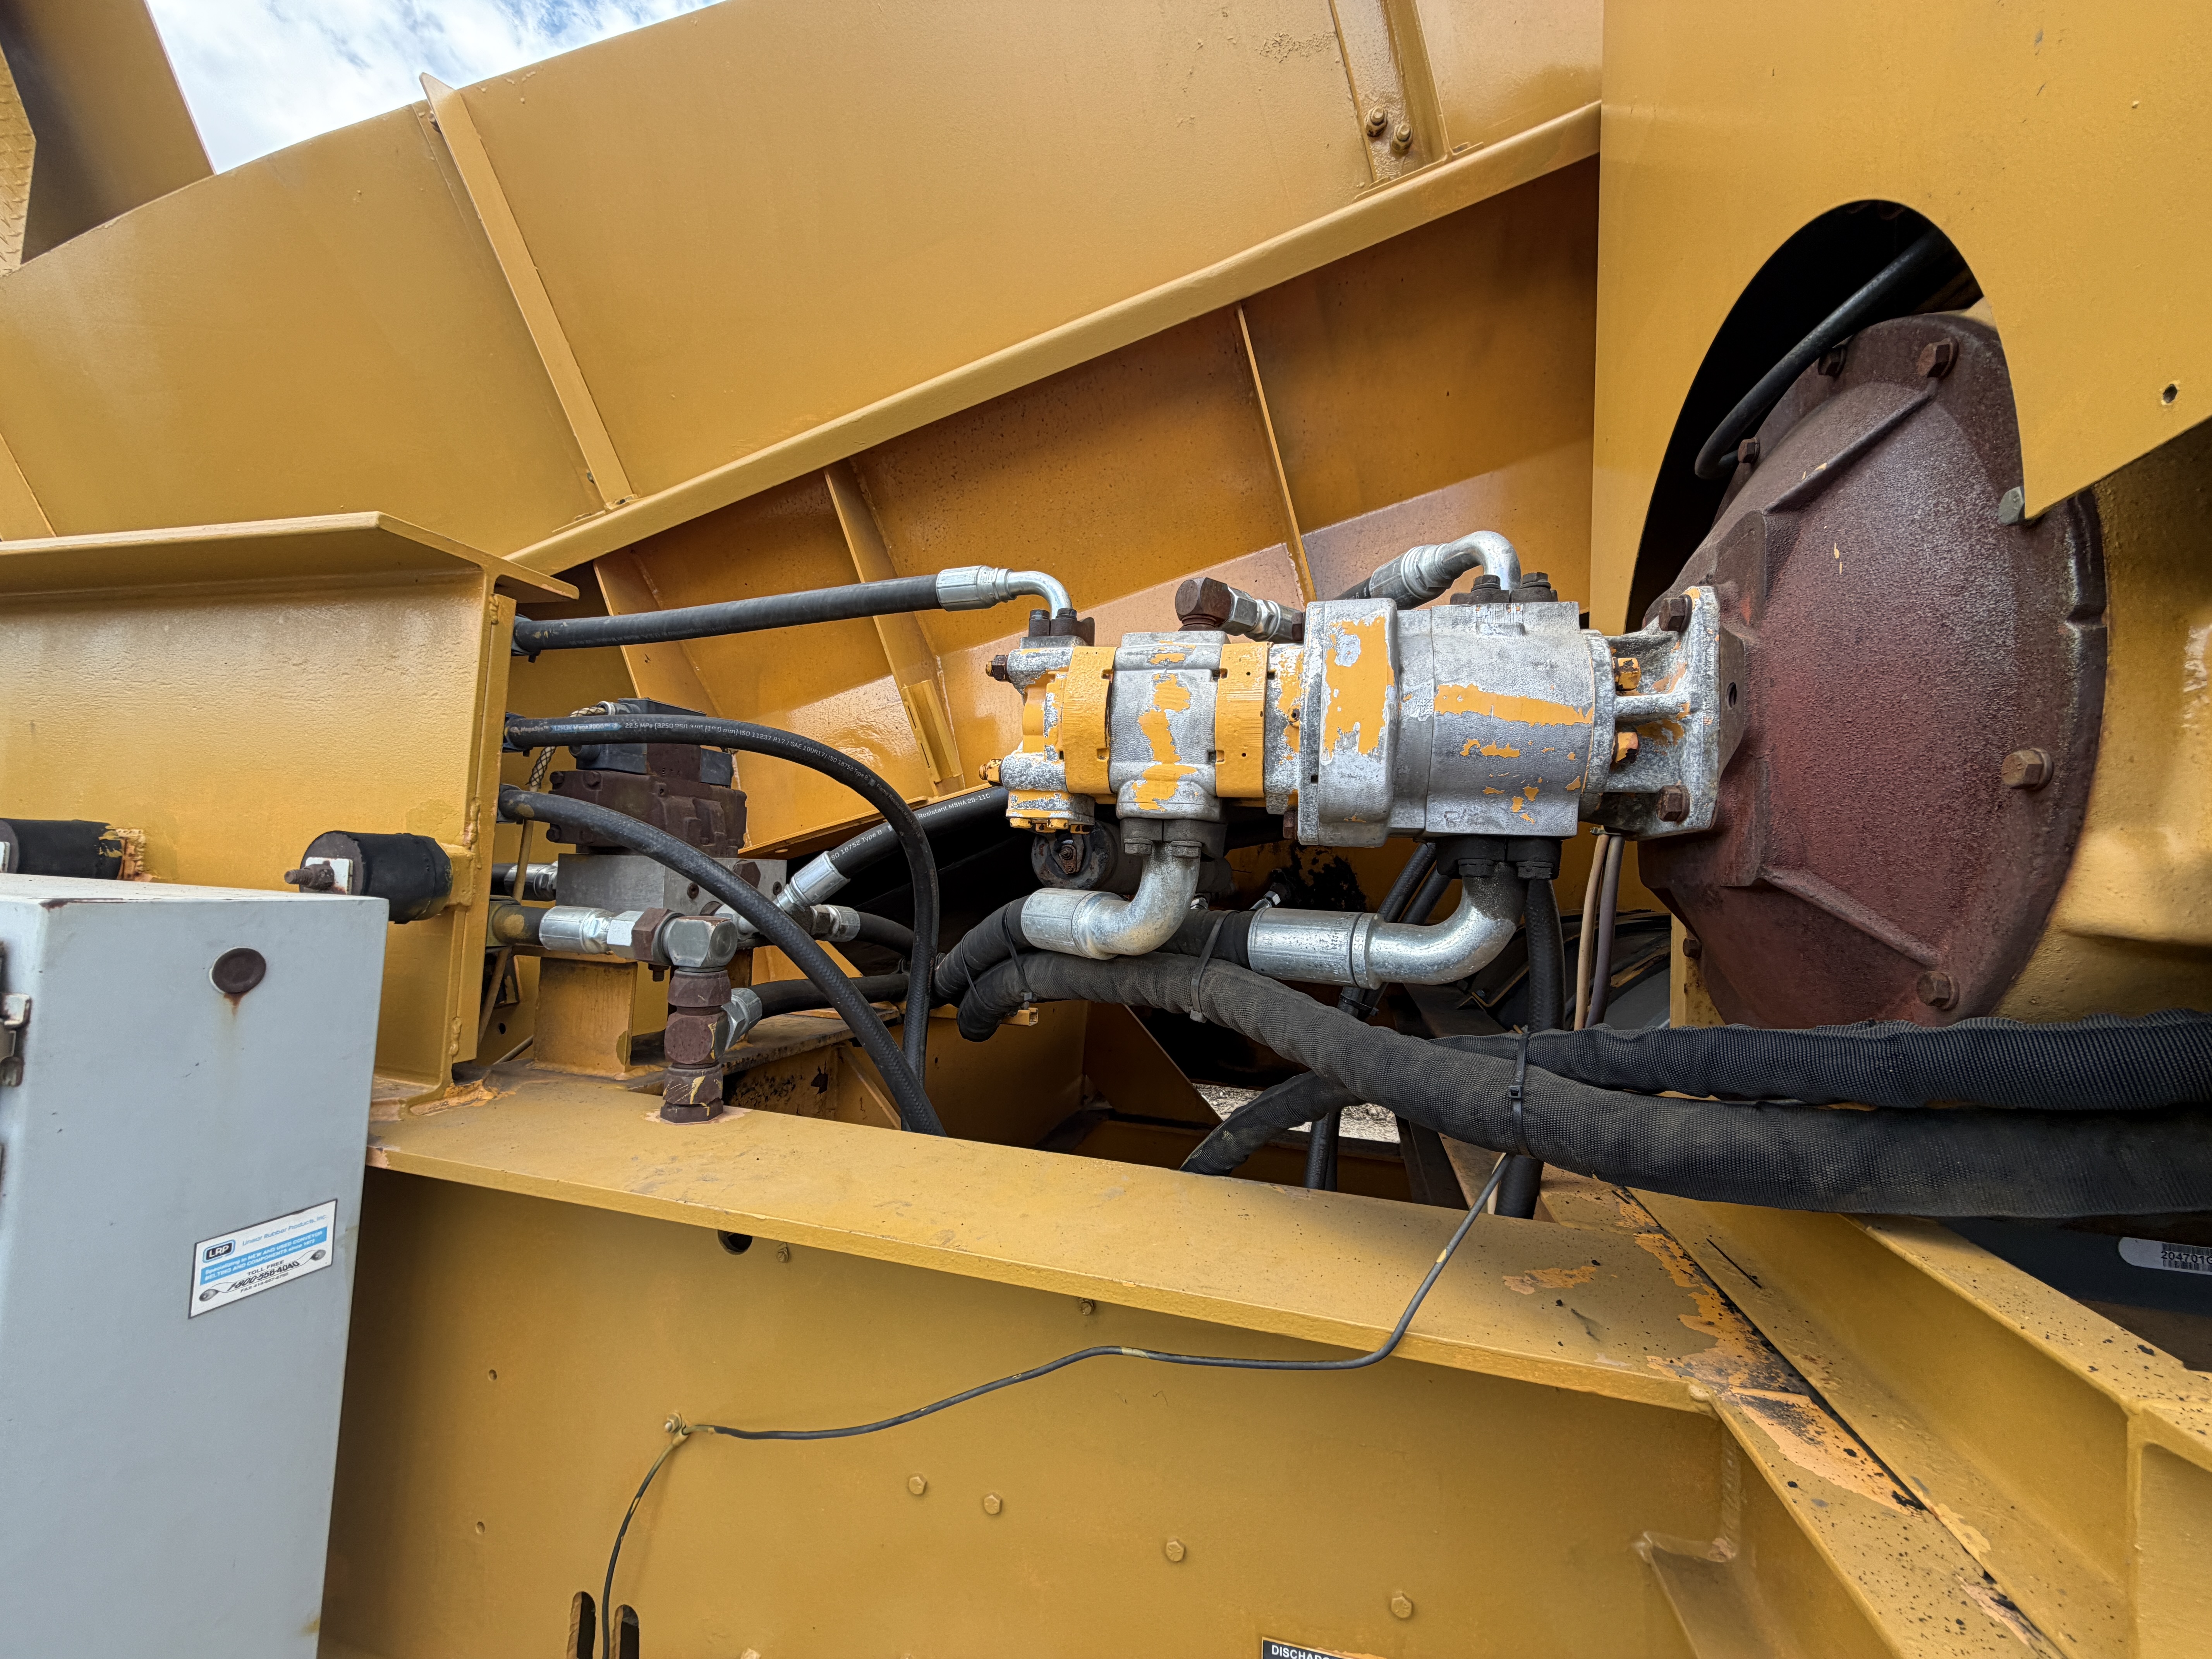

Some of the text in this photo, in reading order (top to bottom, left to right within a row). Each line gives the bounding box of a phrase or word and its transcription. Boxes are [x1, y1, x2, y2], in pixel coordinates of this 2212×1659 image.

[752, 732, 772, 740] 11237
[790, 741, 802, 749] SAE
[838, 760, 854, 771] 18752
[854, 768, 865, 778] Type
[840, 840, 861, 855] 18752
[861, 834, 876, 842] Type
[918, 806, 949, 819] Resistant
[948, 800, 967, 811] MSHA
[968, 793, 991, 804] 2G-11C
[264, 1228, 287, 1238] Rubber
[209, 1245, 229, 1258] LRP
[248, 1252, 263, 1261] NEW
[263, 1247, 276, 1255] AND
[276, 1241, 292, 1250] USED
[292, 1230, 323, 1245] CONVEYOR
[233, 1263, 246, 1271] AND
[247, 1248, 287, 1266] COMPONENTS
[247, 1259, 285, 1276] TOLL FREE
[1271, 1645, 1330, 1659] DISCHA
